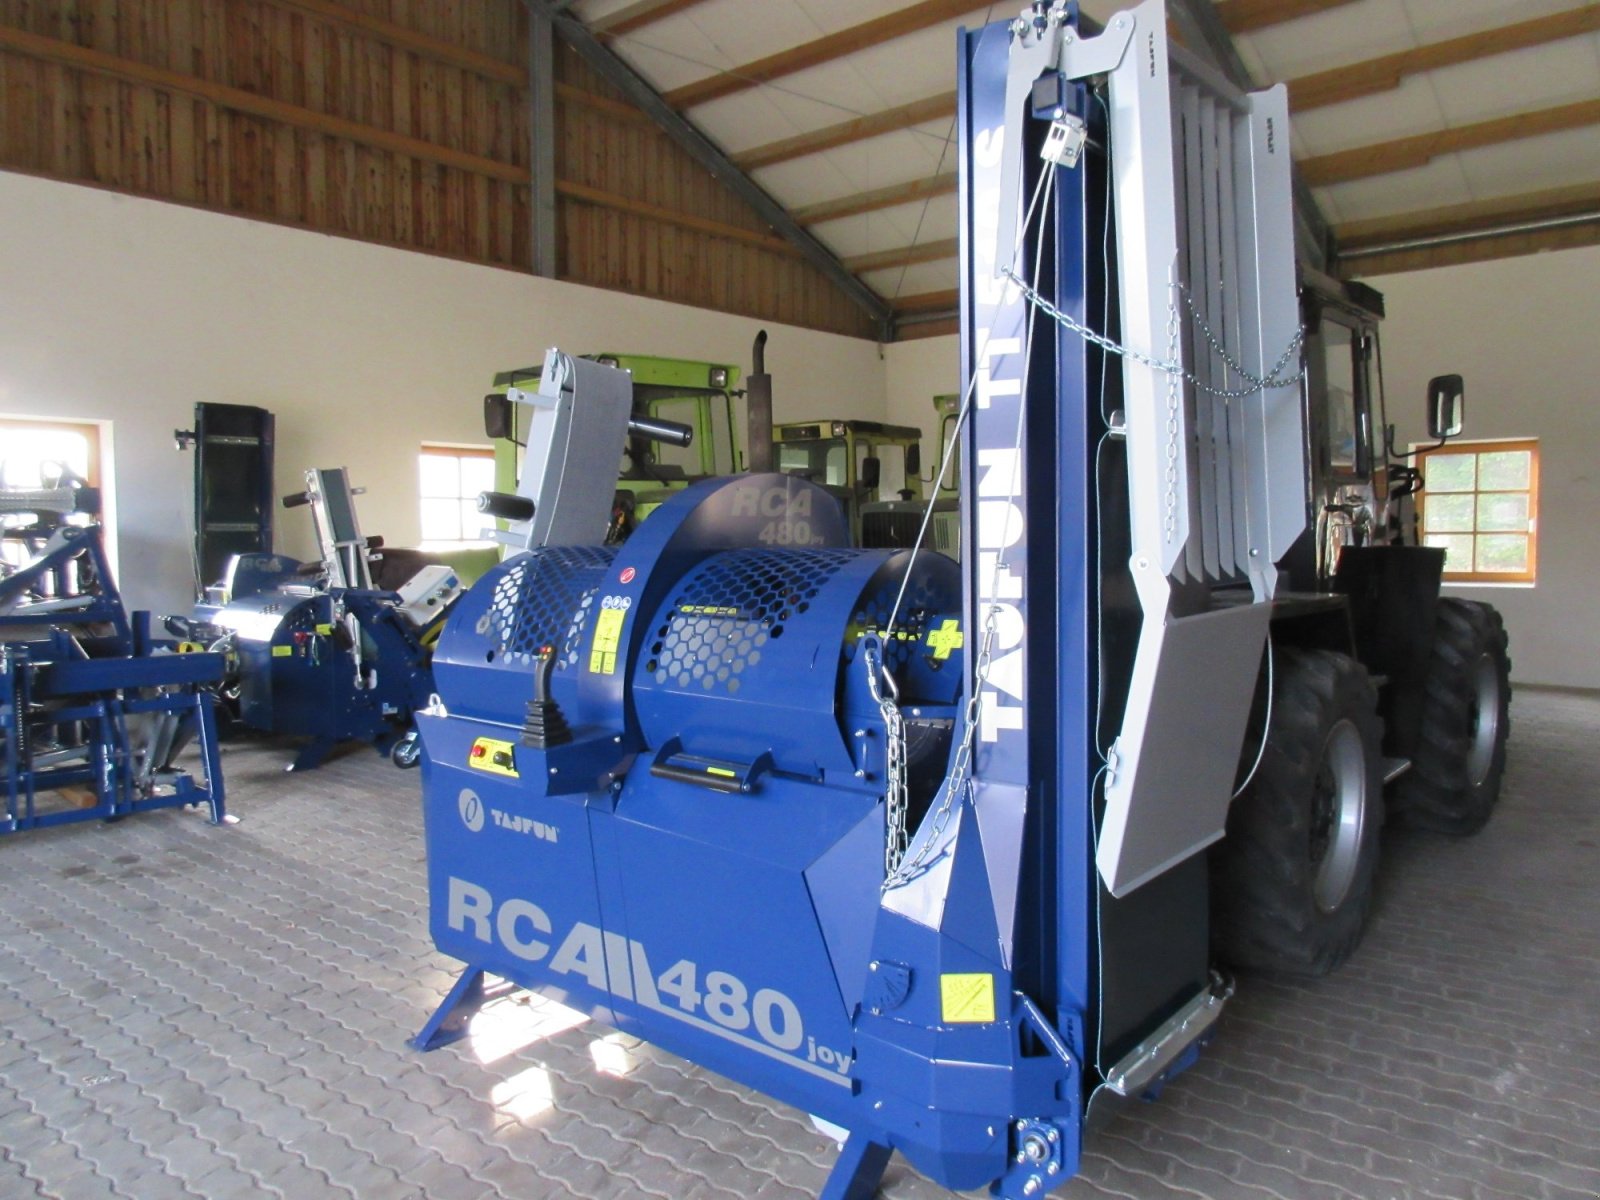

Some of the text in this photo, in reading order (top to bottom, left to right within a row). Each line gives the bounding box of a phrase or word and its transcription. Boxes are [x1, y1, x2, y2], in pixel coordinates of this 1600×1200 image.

[975, 328, 1021, 409] TT
[730, 487, 812, 517] RCA
[758, 521, 811, 545] 480
[977, 447, 1024, 742] TAJFUN
[491, 809, 558, 843] TAJFUN
[448, 876, 851, 1074] RCA 480 joy
